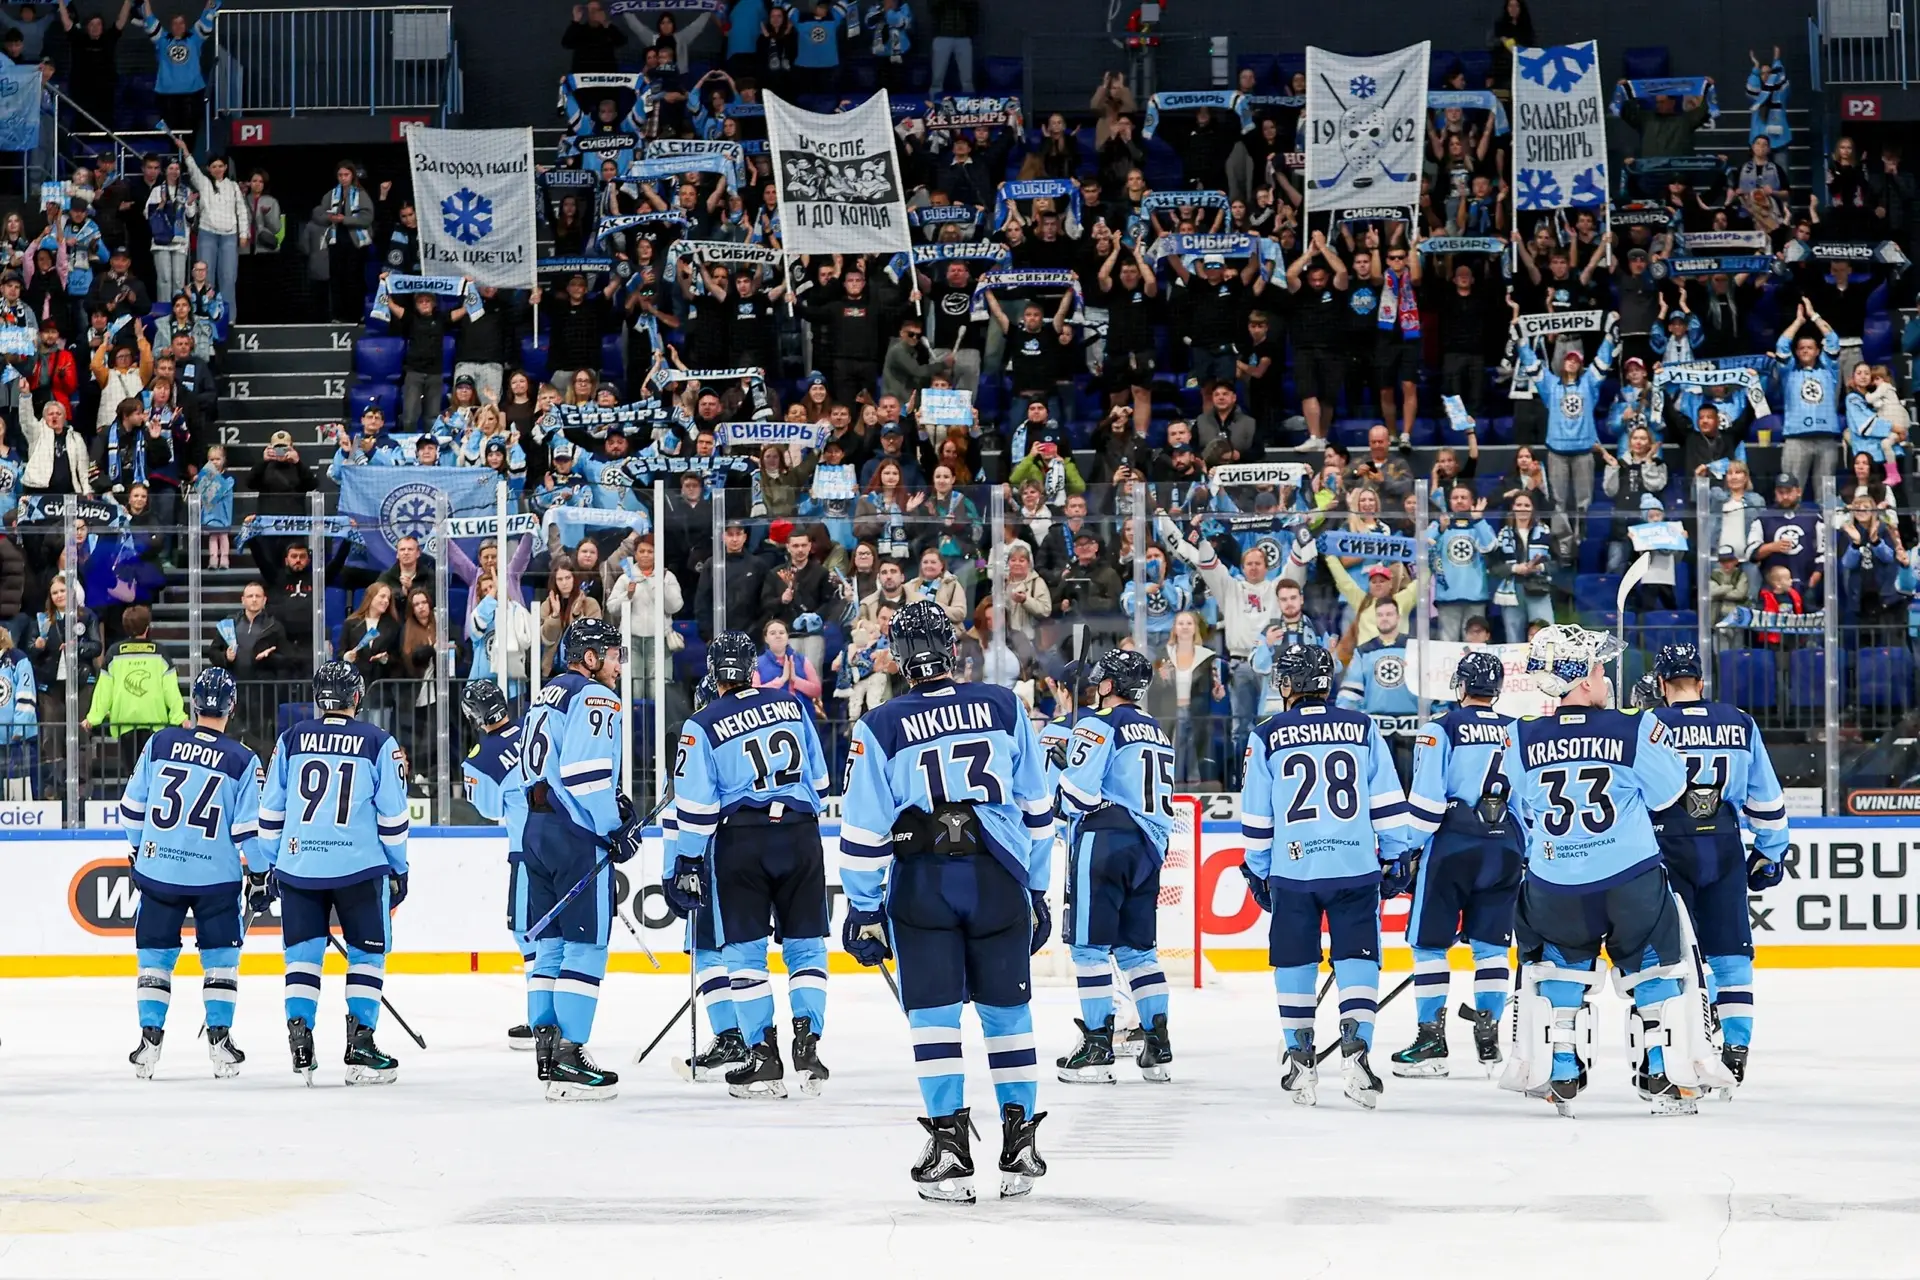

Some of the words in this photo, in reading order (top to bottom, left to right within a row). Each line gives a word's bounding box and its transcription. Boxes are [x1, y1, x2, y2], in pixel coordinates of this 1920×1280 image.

[580, 75, 632, 84] СИБИРЬ
[1164, 95, 1225, 105] СИБИРЬ
[1849, 100, 1876, 116] P2
[1520, 97, 1599, 131] СЛАВЬСЯ
[241, 124, 263, 141] P1
[1312, 119, 1335, 144] 19
[1392, 118, 1415, 143] 62
[579, 137, 634, 150] СИБИРЬ
[1526, 133, 1593, 163] СИБИРЬ
[1011, 182, 1066, 197] СИБИРЬ
[796, 204, 806, 226] И
[812, 205, 834, 229] ДО
[840, 204, 891, 231] КОНЦА
[922, 207, 971, 220] СИБИРЬ
[1343, 208, 1403, 219] СИБИРЬ
[1610, 213, 1669, 225] СИБИРЬ
[1182, 233, 1250, 249] СИБИРЬ
[1428, 239, 1491, 249] СИБИРЬ
[424, 243, 436, 260] И
[709, 248, 775, 261] СИБИРЬ
[943, 242, 1006, 260] СИБИРЬ
[1812, 245, 1874, 257] СИБИРЬ
[1674, 259, 1718, 271] СИБИРЬ
[394, 280, 454, 291] СИБИРЬ
[1526, 316, 1594, 333] СИБИРЬ
[237, 333, 260, 351] 14
[330, 332, 352, 351] 14
[228, 381, 250, 398] 13
[323, 379, 346, 397] 13
[567, 407, 668, 424] СИБИРЬ
[218, 426, 241, 444] 12
[732, 424, 813, 439] СИБИРЬ
[628, 456, 749, 475] СИБИРЬ
[1219, 470, 1290, 482] СИБИРЬ
[1339, 539, 1413, 558] СИБИРЬ
[726, 668, 737, 680] 12
[920, 664, 933, 677] 13
[1489, 669, 1496, 680] 6
[206, 695, 217, 707] 34
[588, 708, 614, 740] 96
[713, 699, 802, 743] NEKOLENKO
[901, 702, 993, 743] NIKULIN
[300, 732, 364, 755] VALITOV
[1269, 721, 1365, 751] PERSHAKOV
[1673, 724, 1747, 747] ZABALAYEV
[171, 742, 224, 769] POPOV
[743, 728, 803, 793] 12
[1527, 737, 1624, 768] KRASOTKIN
[674, 748, 687, 778] 2
[915, 737, 1005, 814] 13
[1480, 749, 1510, 796] 6
[1140, 746, 1174, 817] 15
[1281, 748, 1361, 826] 28
[297, 757, 357, 827] 91
[151, 763, 225, 841] 34
[1537, 765, 1617, 837] 33
[1855, 795, 1920, 810] WINLINE
[1304, 839, 1360, 849] НОВОСИБИРСКАЯ
[1305, 846, 1336, 855] ОБЛАСТЬ
[1556, 837, 1616, 852] НОВОСИБИРСКАЯ
[159, 846, 212, 861] НОВОСИБИРСКАЯ
[159, 853, 187, 863] ОБЛАСТЬ
[1557, 851, 1589, 859] ОБЛАСТЬ
[1745, 842, 1920, 879] RIBU
[1797, 894, 1920, 931] CLU
[930, 1154, 955, 1178] CCM
